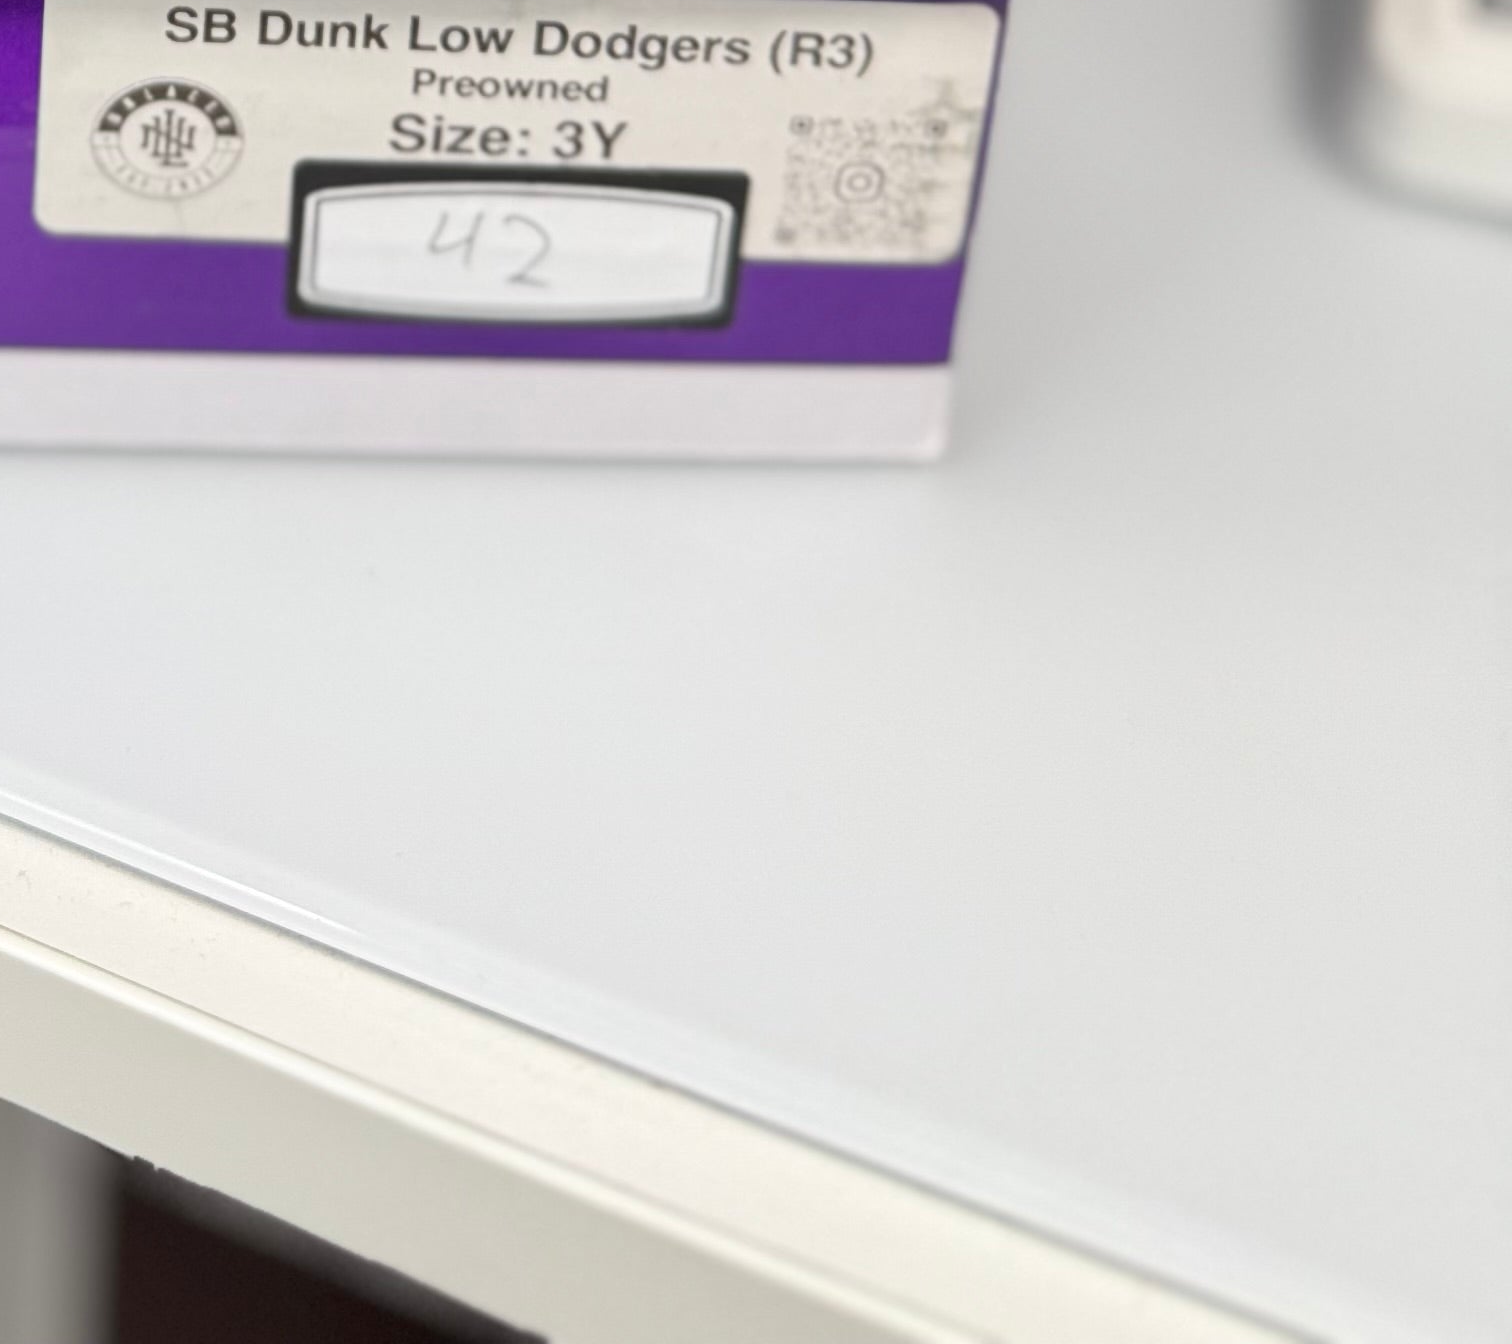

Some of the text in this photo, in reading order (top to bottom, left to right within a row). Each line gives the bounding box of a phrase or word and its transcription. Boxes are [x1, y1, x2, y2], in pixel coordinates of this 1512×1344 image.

[165, 6, 874, 79] SB Dunk Low Dodgers (R3)
[411, 67, 610, 103] Preowned
[388, 113, 628, 160] Size: 3Y
[428, 210, 551, 288] 42
